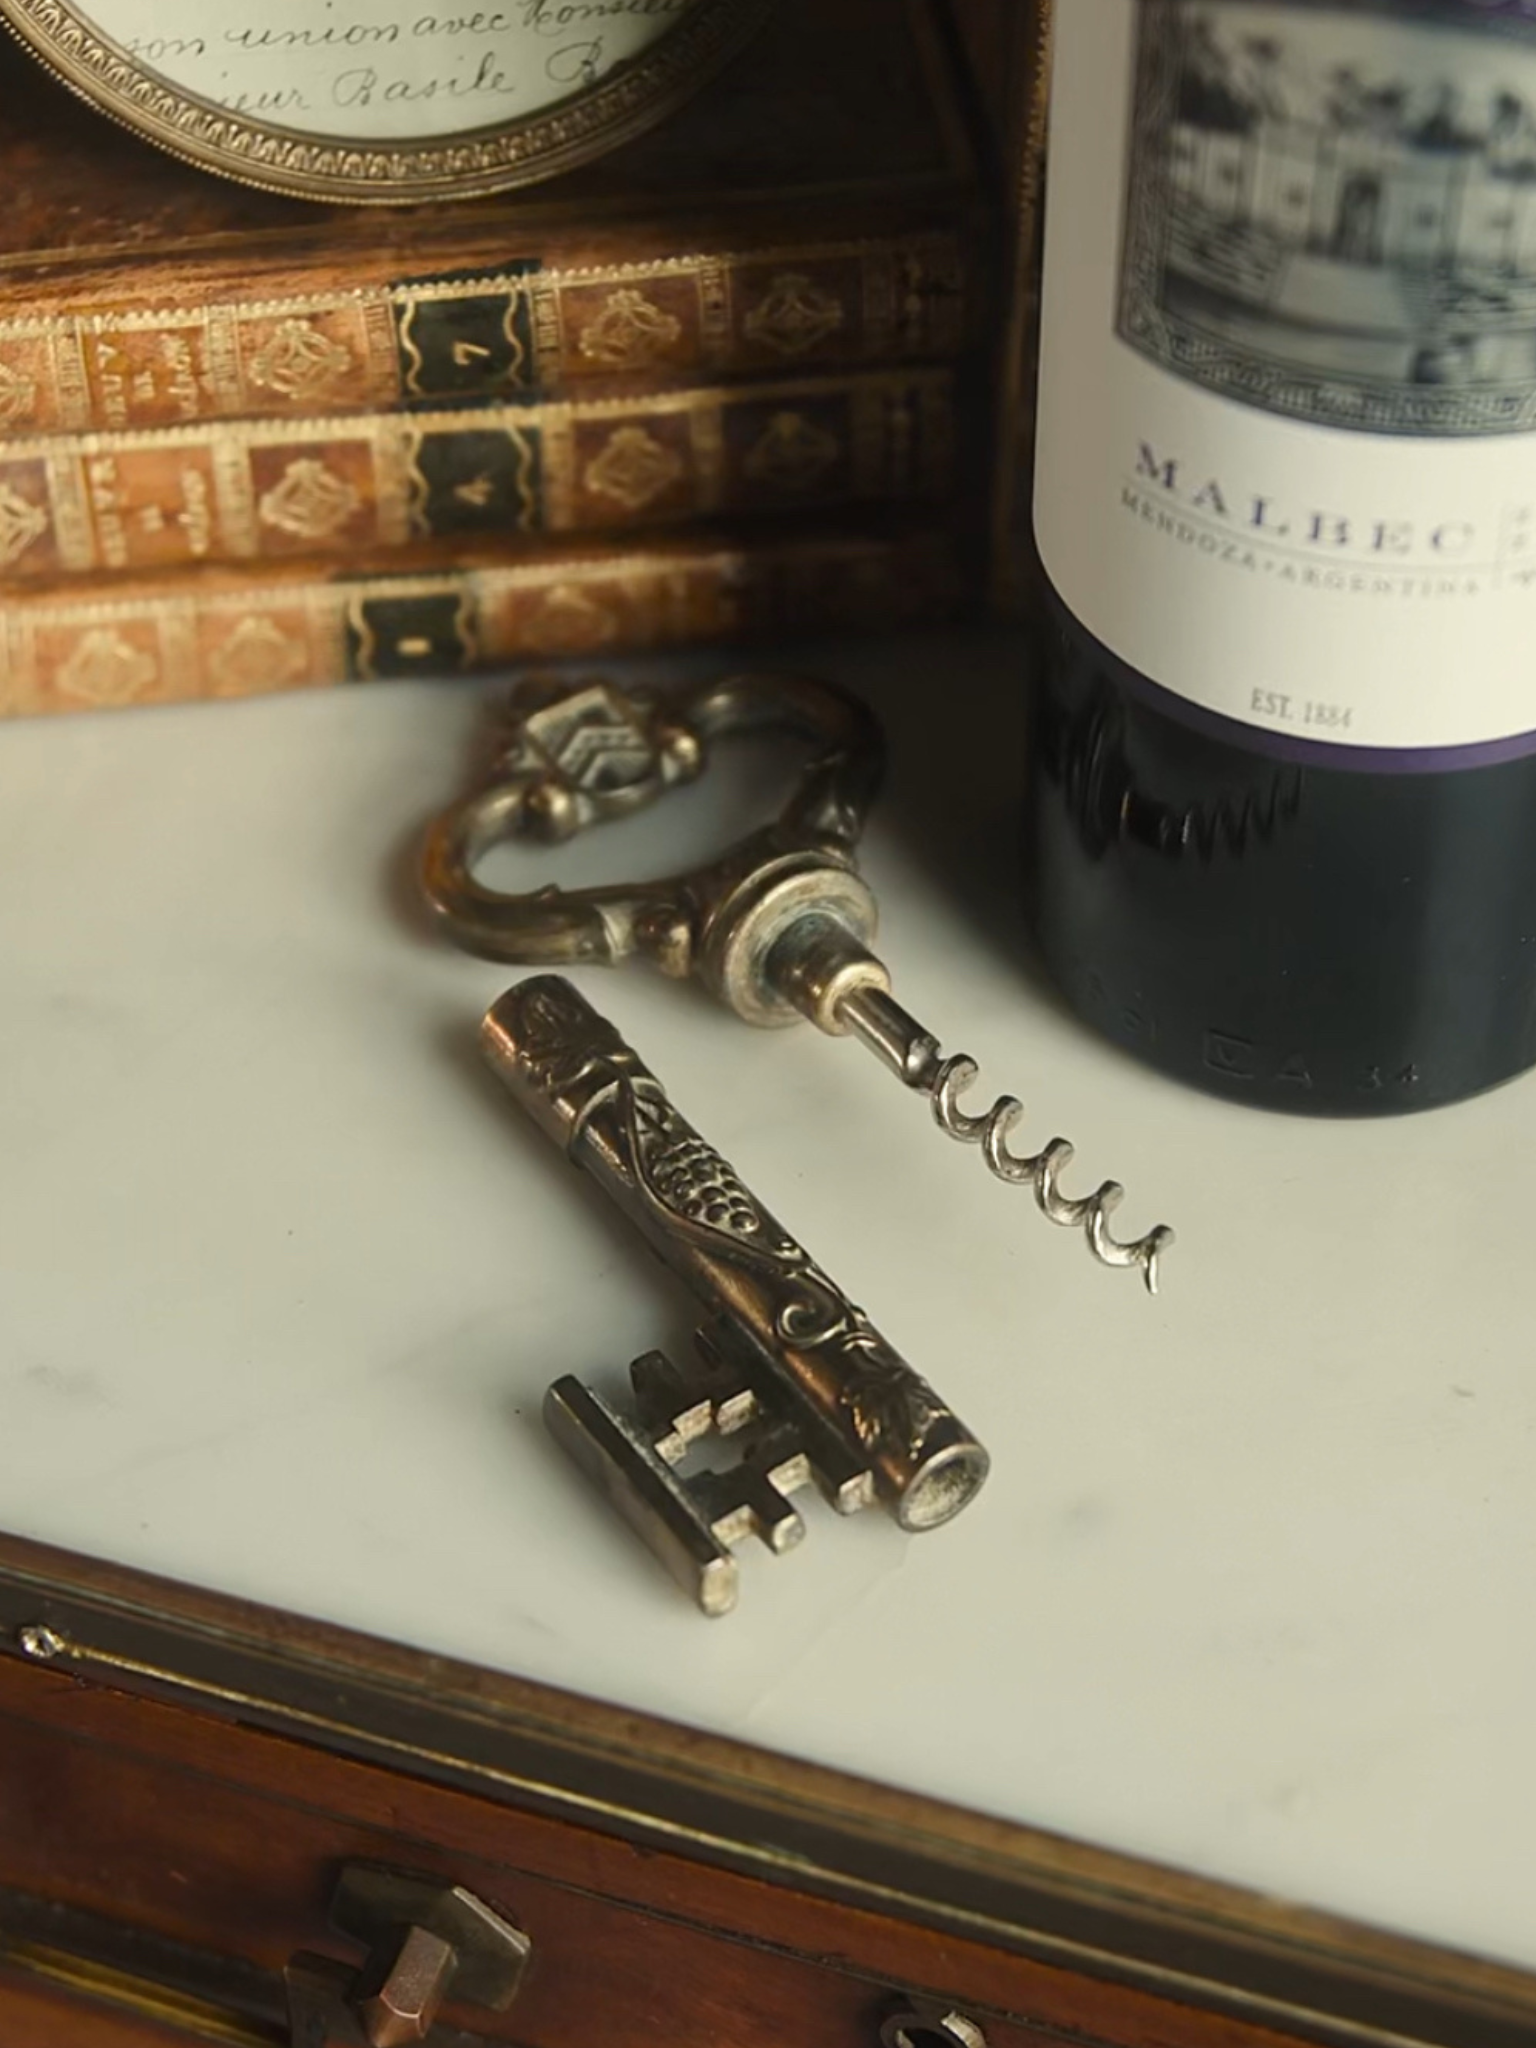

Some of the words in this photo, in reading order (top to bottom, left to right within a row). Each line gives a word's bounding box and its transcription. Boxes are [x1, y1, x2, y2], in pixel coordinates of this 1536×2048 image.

[223, 1, 400, 47] union
[412, 12, 511, 36] avec
[332, 51, 516, 107] Basile
[453, 340, 491, 366] 7
[1134, 440, 1477, 557] MALBEC
[1121, 486, 1258, 573] MENDOZA
[1250, 686, 1294, 720] EST.
